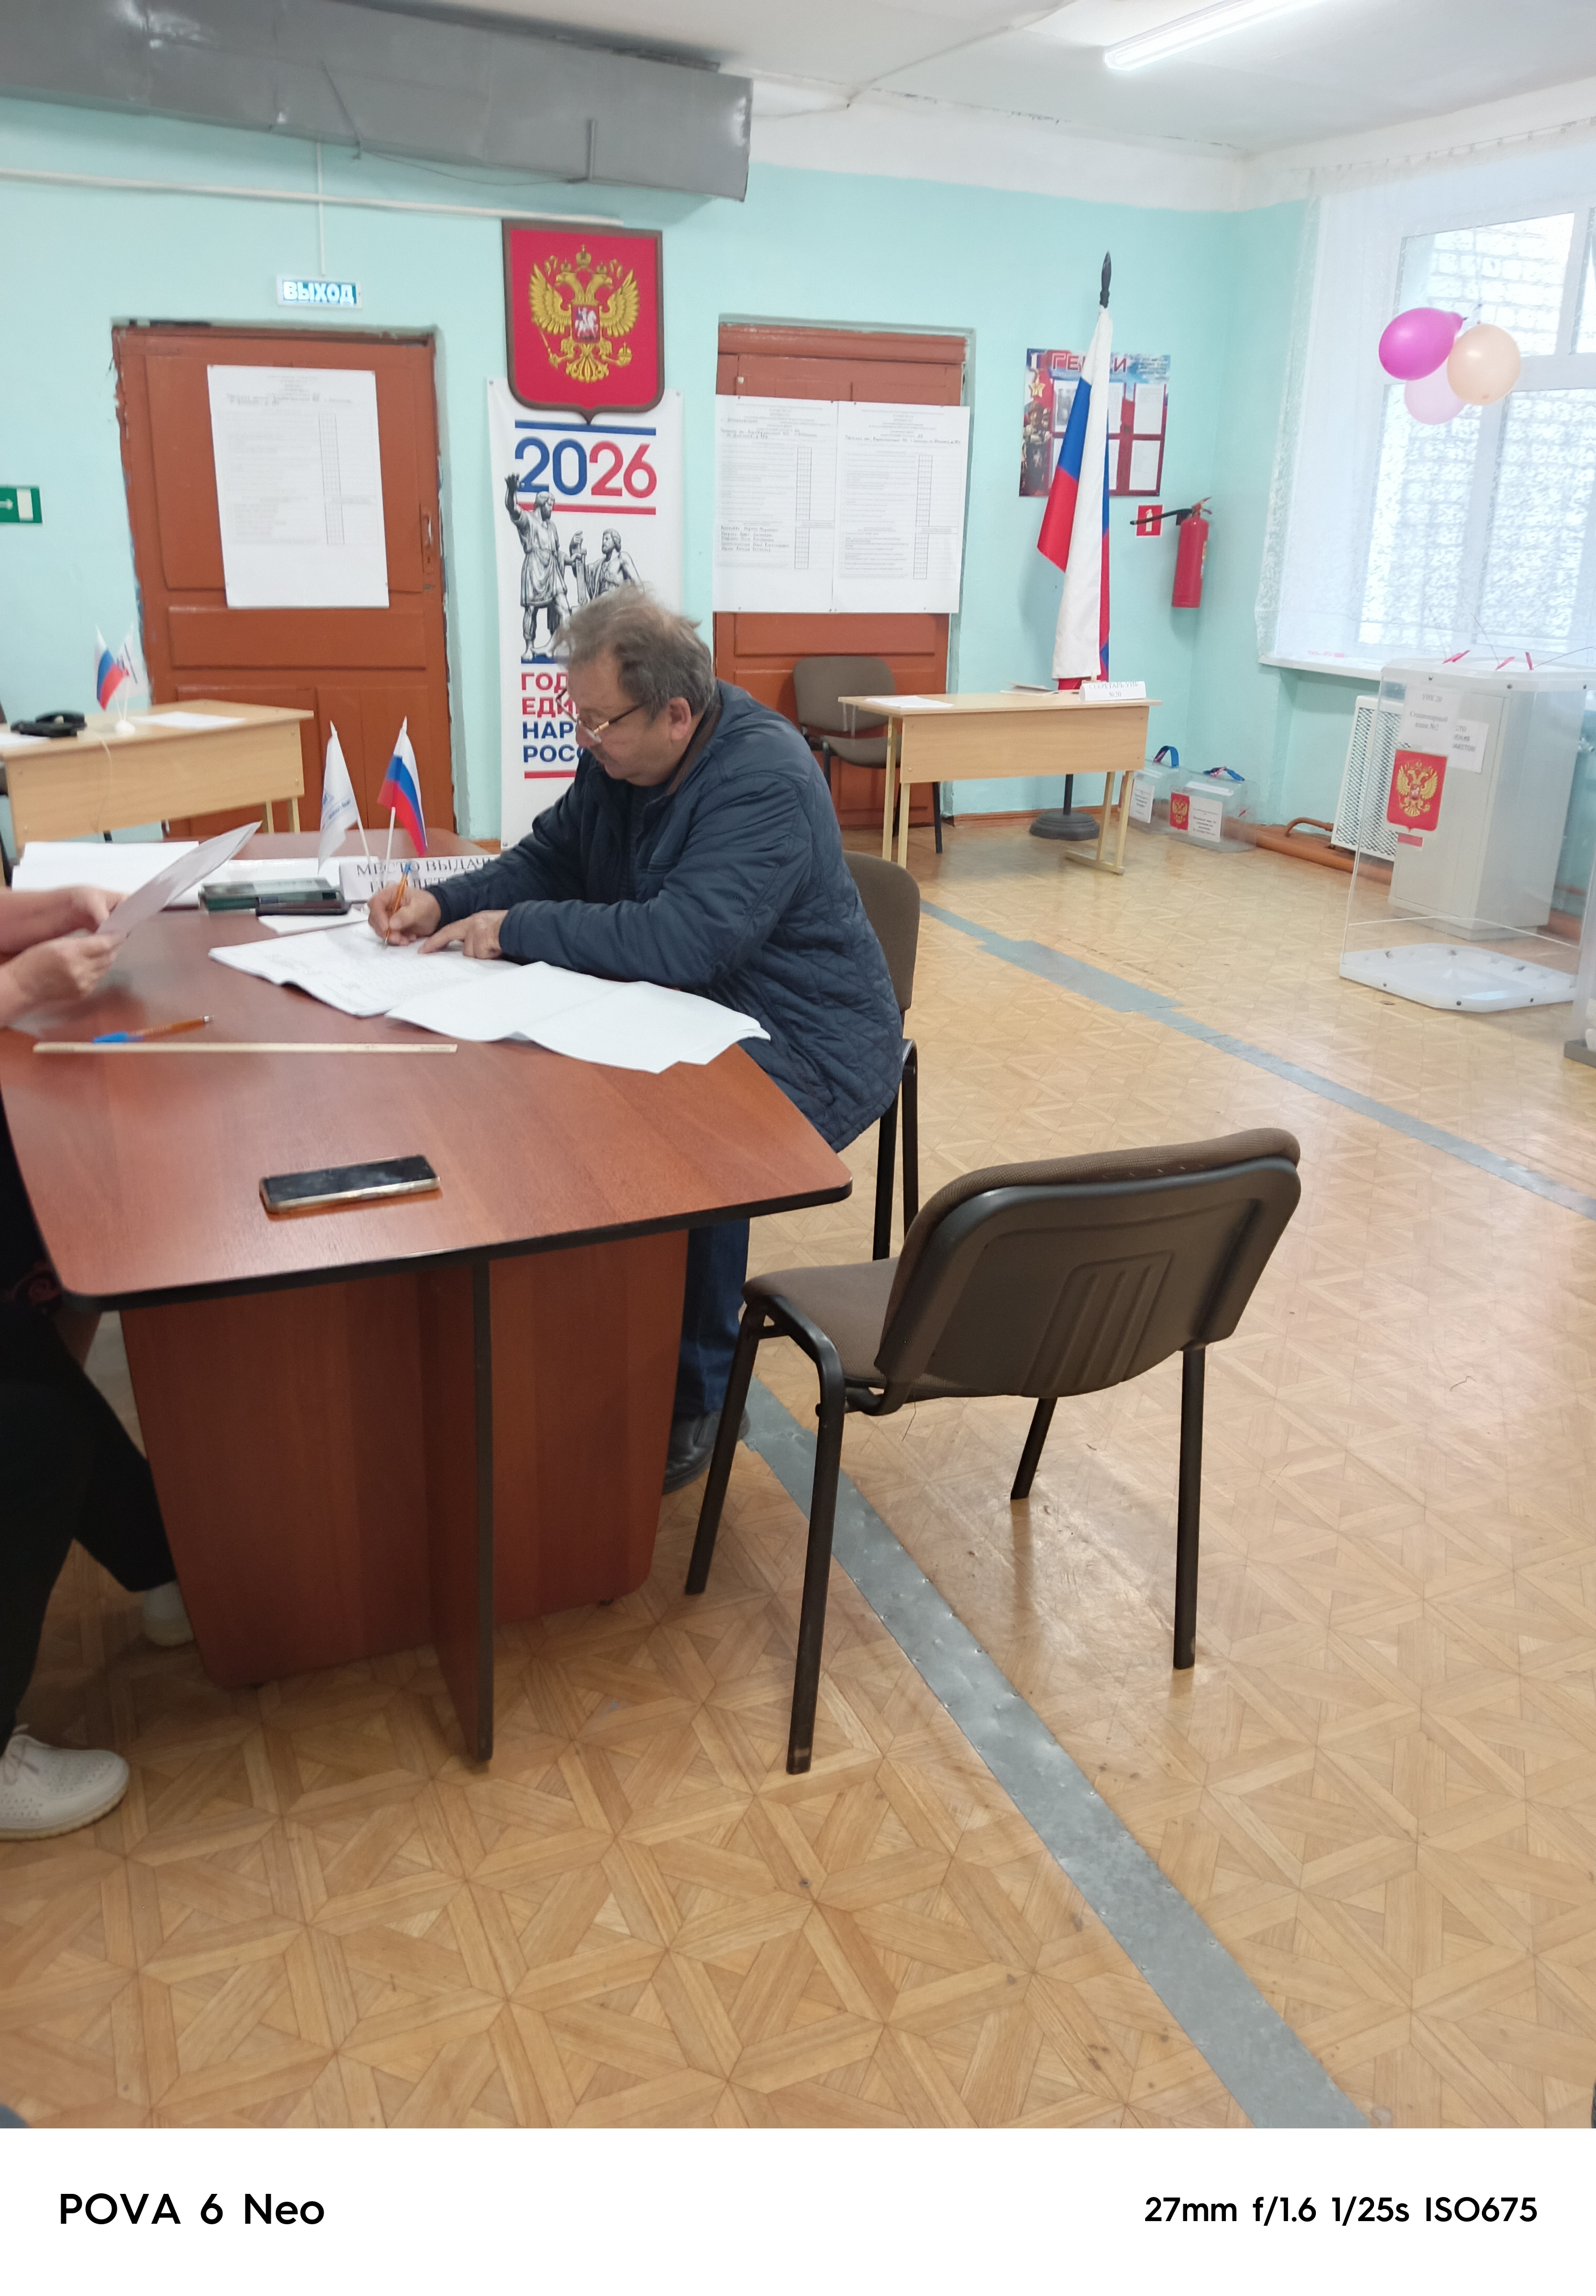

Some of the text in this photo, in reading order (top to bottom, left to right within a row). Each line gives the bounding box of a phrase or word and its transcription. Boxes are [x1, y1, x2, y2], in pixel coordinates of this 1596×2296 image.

[283, 281, 354, 306] ВЫХОД
[1052, 353, 1127, 372] ГЕИ
[515, 436, 657, 498] 2026
[522, 697, 579, 718] ЕДИ
[523, 721, 576, 739] НАР
[357, 860, 420, 875] МЕСТО
